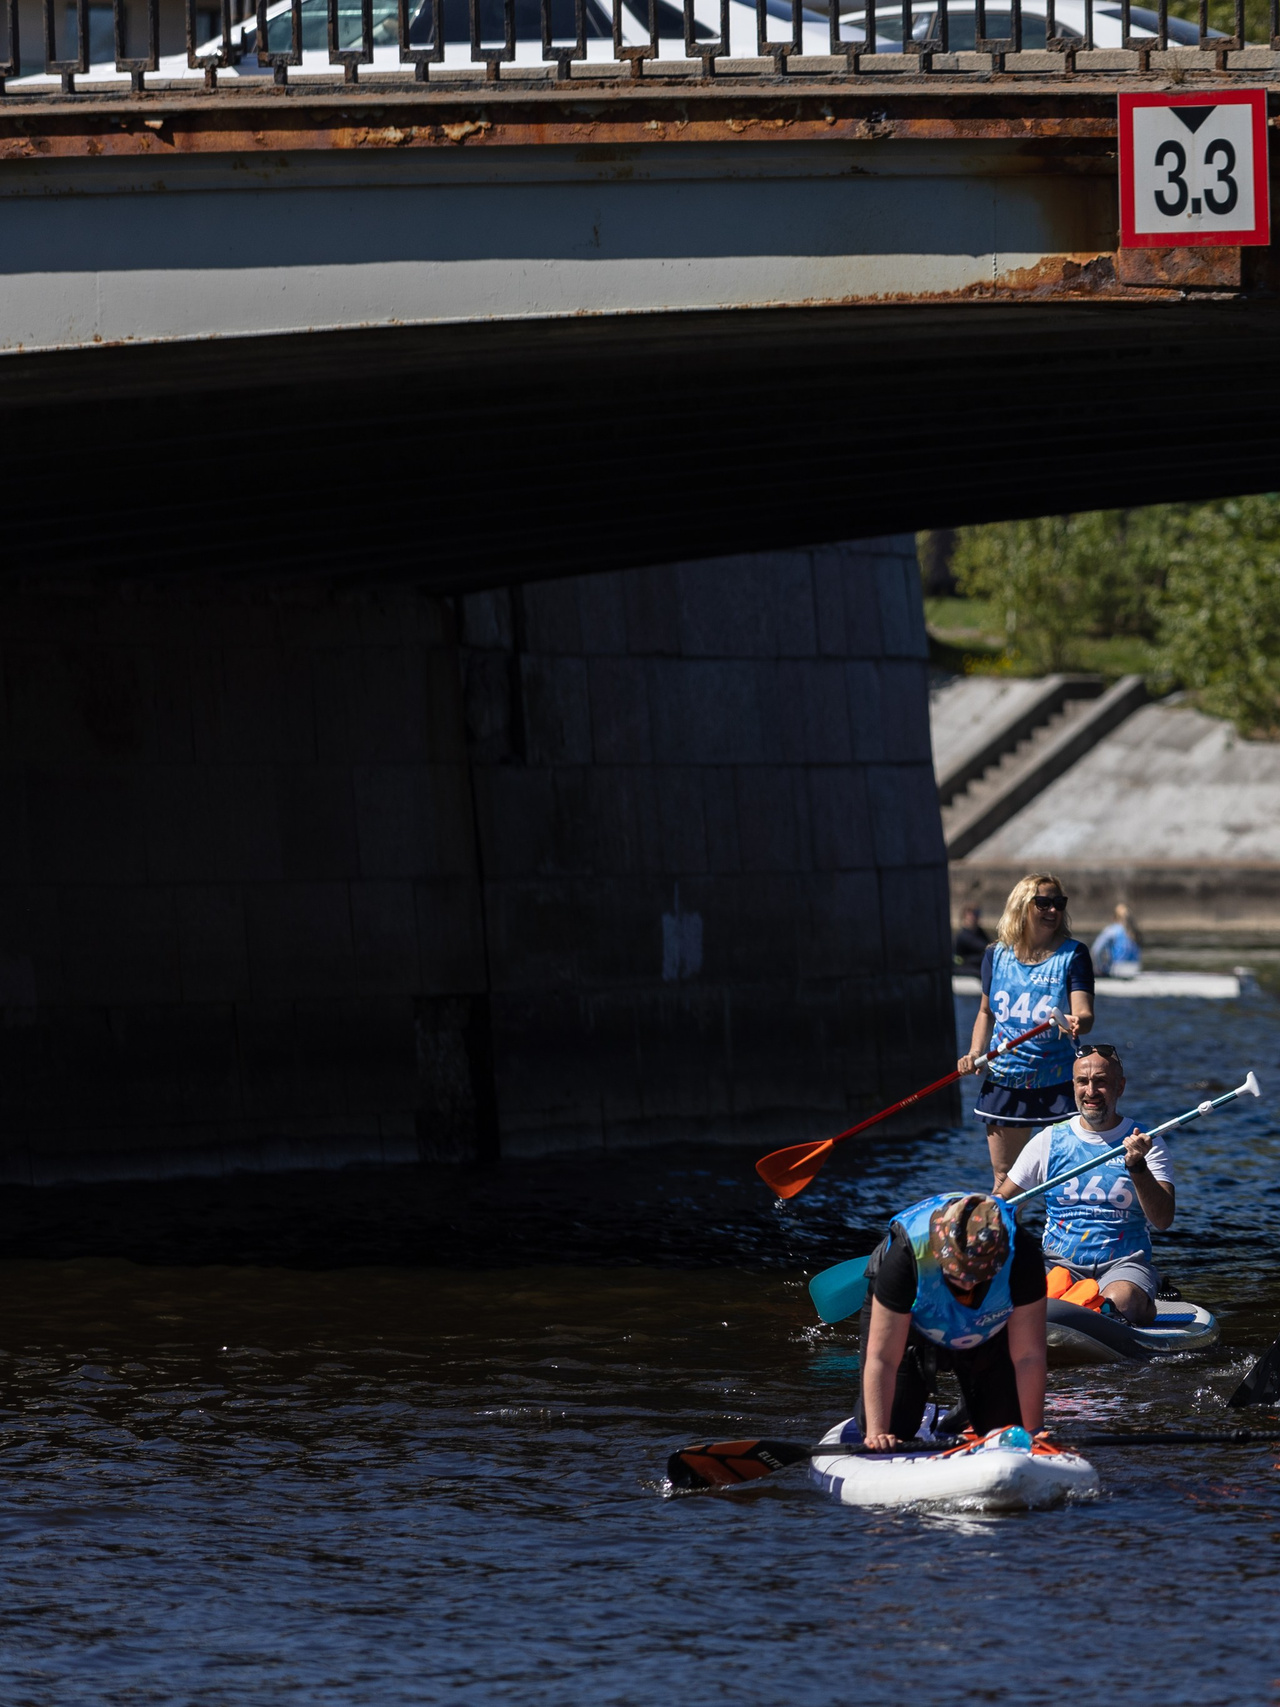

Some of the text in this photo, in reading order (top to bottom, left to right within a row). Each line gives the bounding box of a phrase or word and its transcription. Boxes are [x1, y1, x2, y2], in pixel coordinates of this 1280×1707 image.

[1154, 138, 1238, 216] 3.3
[993, 990, 1053, 1025] 346
[1056, 1175, 1133, 1210] 366
[758, 1451, 784, 1469] ELITE
